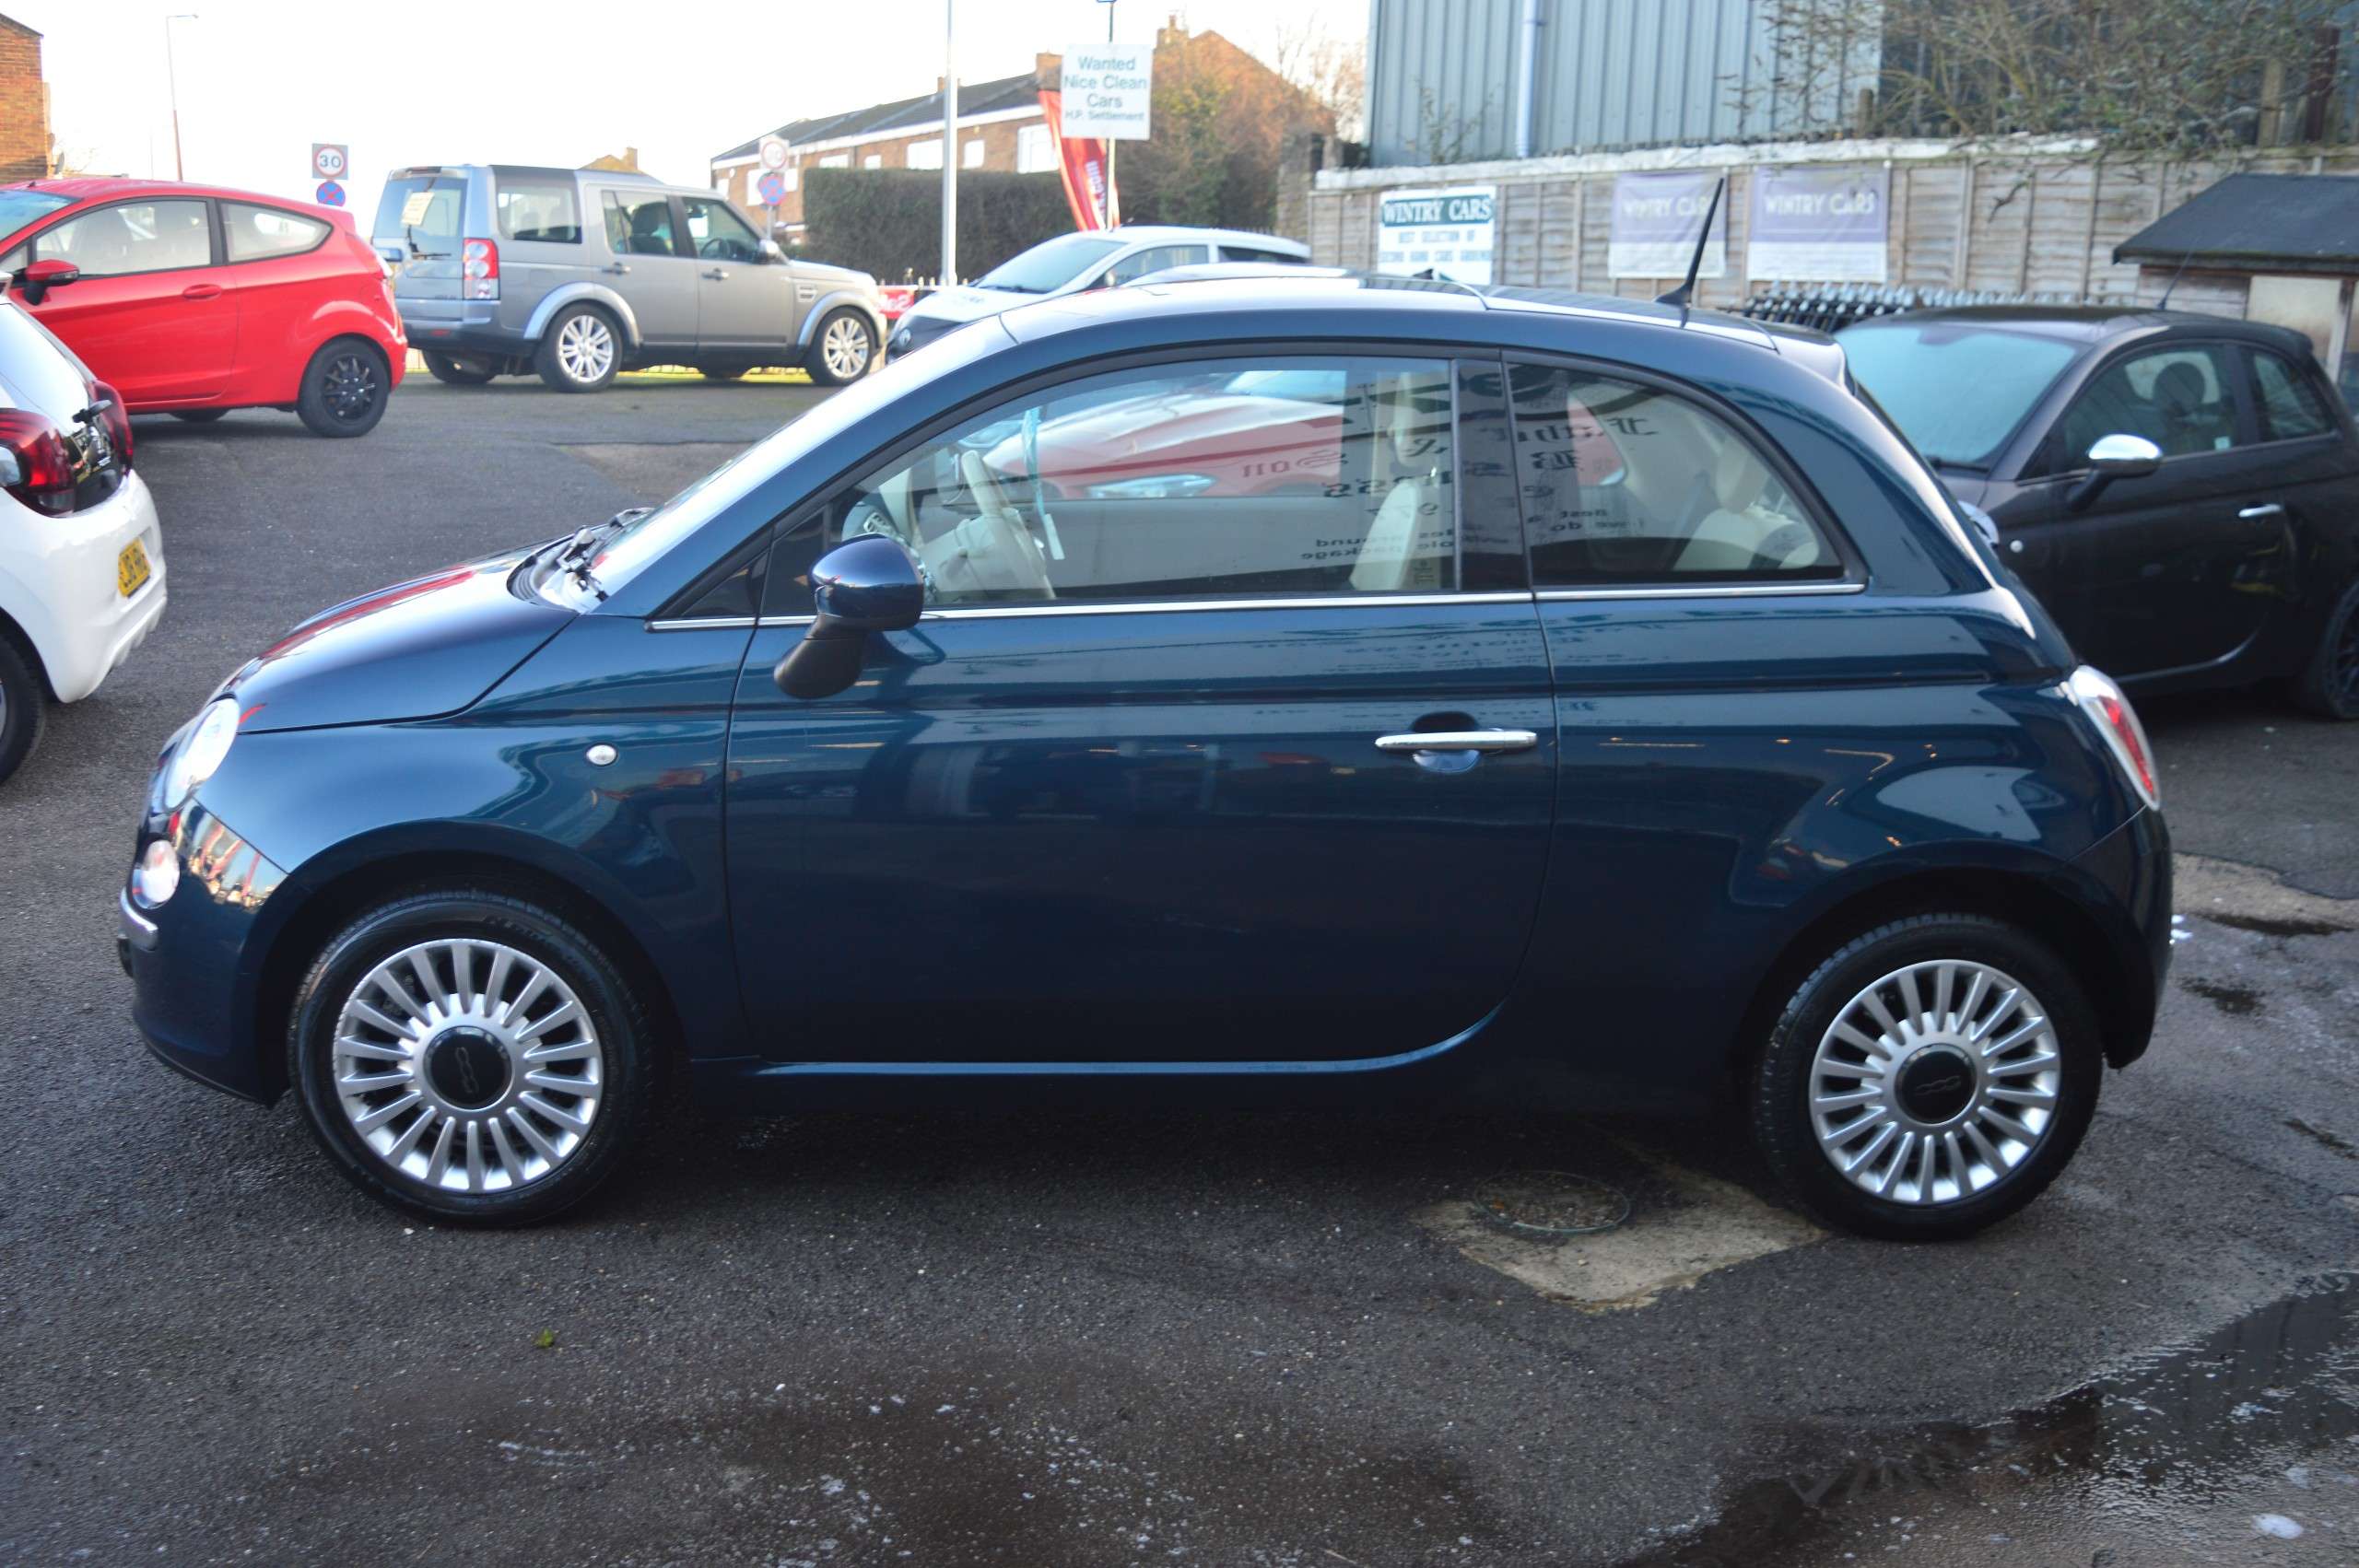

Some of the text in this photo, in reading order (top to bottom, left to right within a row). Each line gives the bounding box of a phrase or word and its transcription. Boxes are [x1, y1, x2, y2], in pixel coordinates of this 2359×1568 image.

[1078, 56, 1136, 71] Wanted
[1064, 76, 1147, 89] Nice Clean
[1086, 93, 1122, 108] Cars
[319, 154, 342, 169] 30
[1449, 197, 1492, 221] CARS
[1764, 193, 1825, 216] WINTRY
